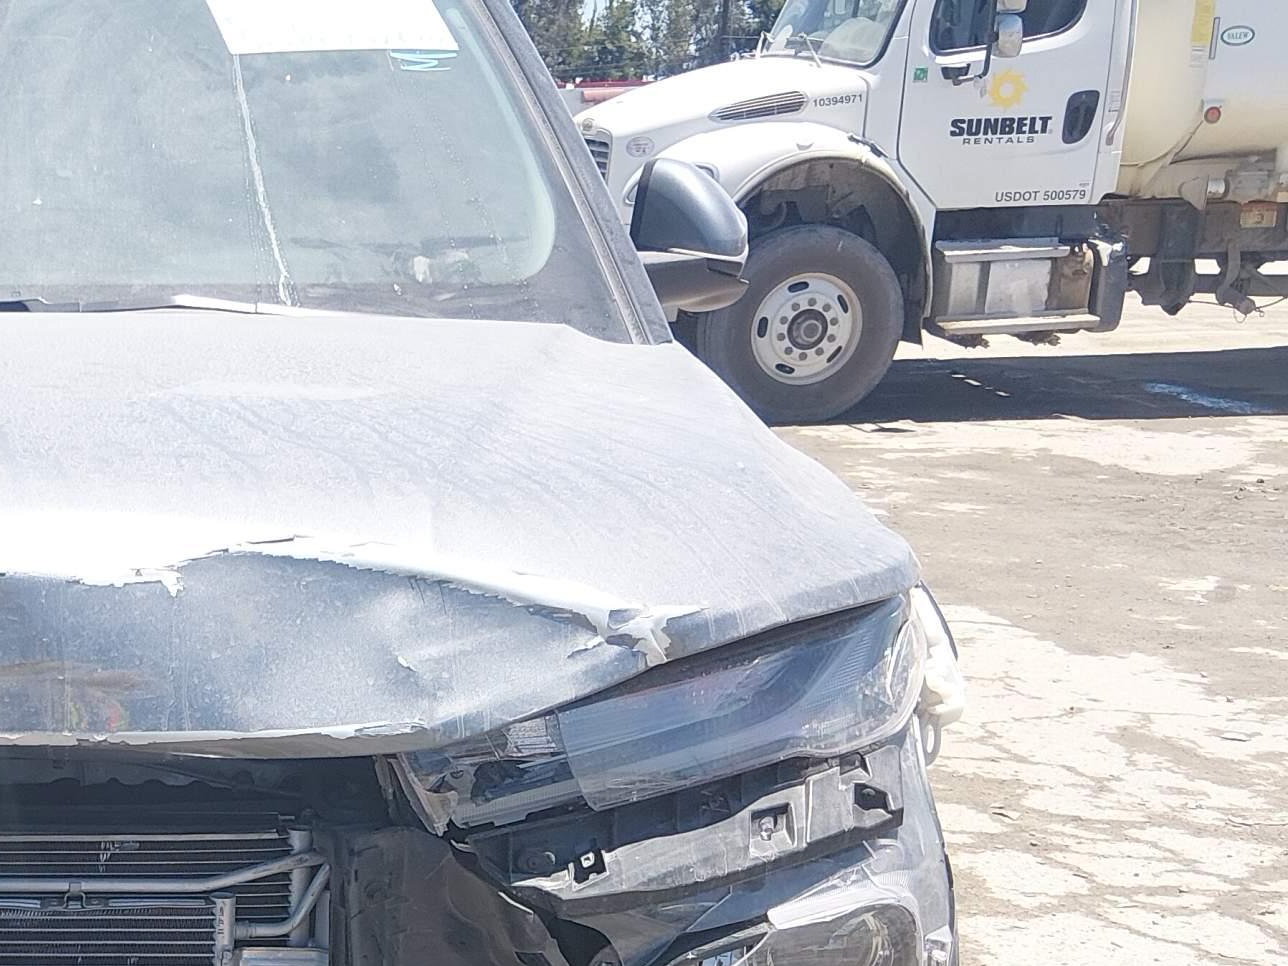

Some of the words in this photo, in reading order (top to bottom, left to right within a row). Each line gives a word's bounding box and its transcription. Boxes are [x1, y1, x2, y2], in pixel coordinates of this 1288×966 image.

[813, 94, 863, 107] 10394971
[949, 116, 1052, 137] SUNBELT
[962, 136, 1035, 145] RENTALS
[995, 190, 1041, 202] USDOT
[1043, 189, 1086, 201] 500579
